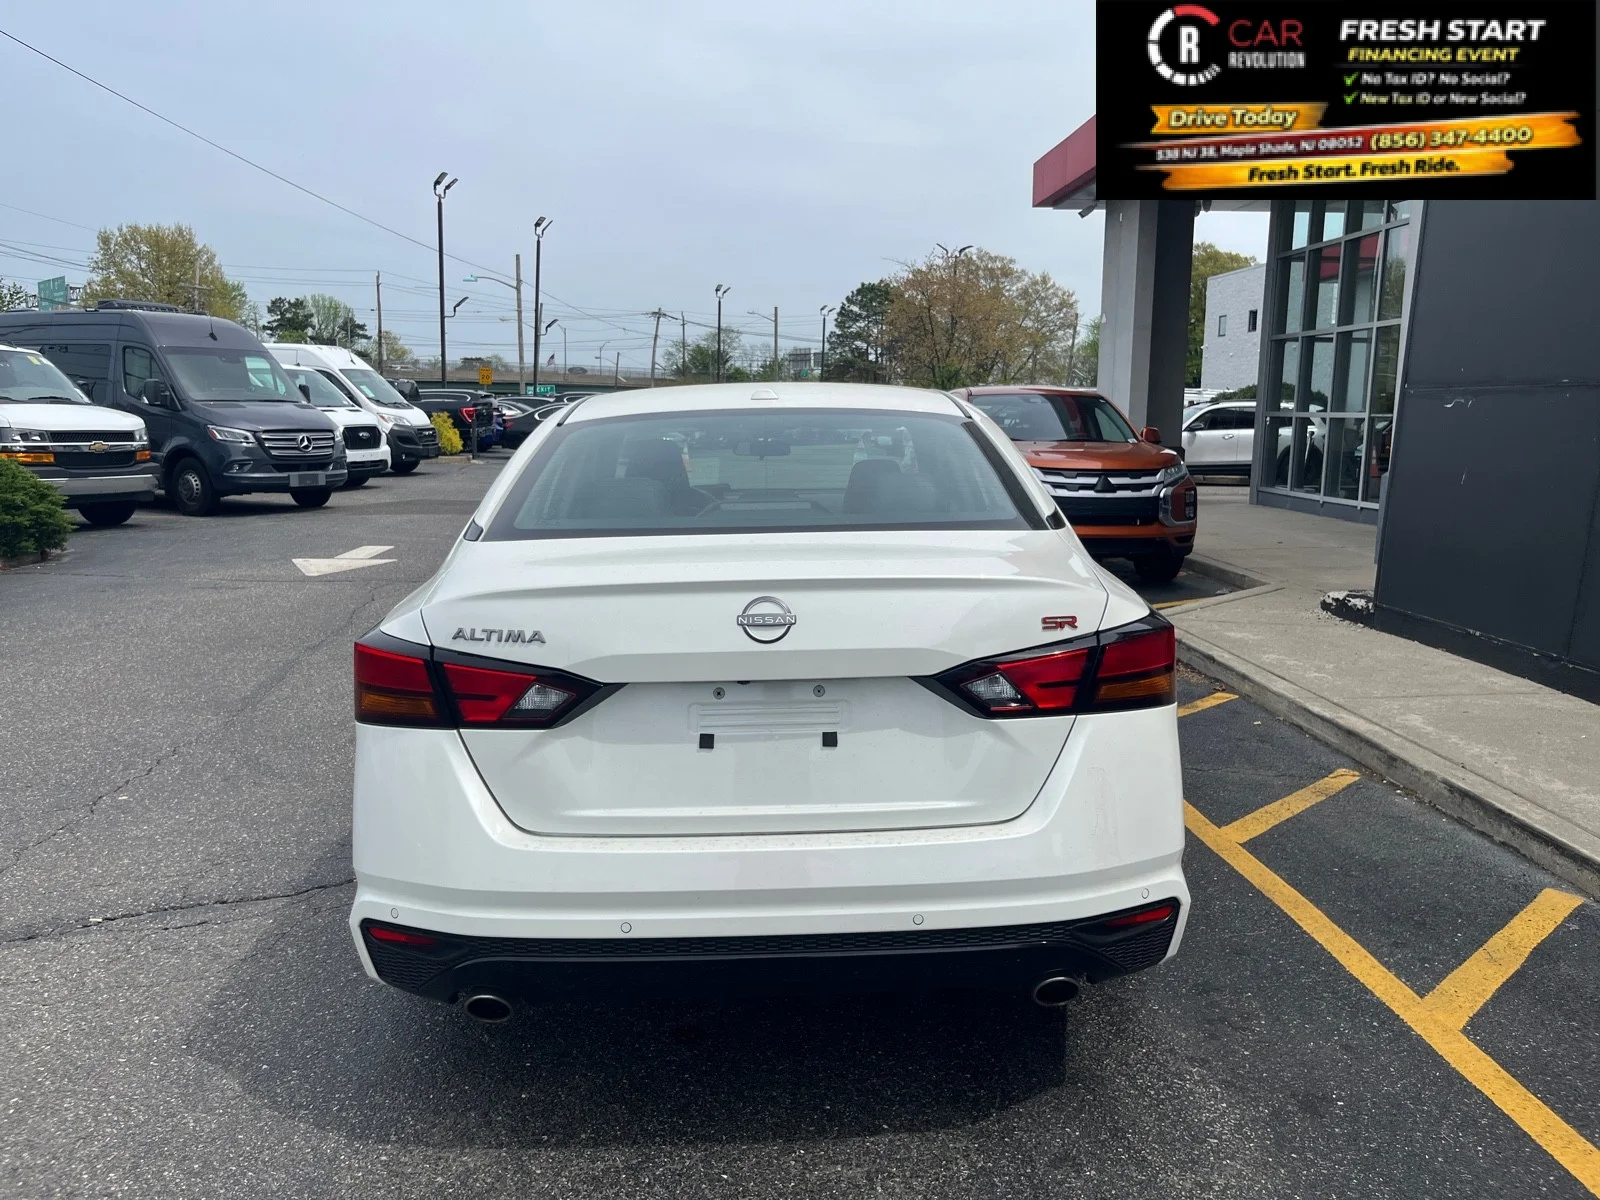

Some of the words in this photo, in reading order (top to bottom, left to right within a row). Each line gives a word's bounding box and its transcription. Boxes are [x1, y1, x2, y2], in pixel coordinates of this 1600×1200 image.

[738, 616, 795, 624] NISSAN
[1041, 615, 1078, 630] SR
[451, 627, 547, 644] ALTIMA
